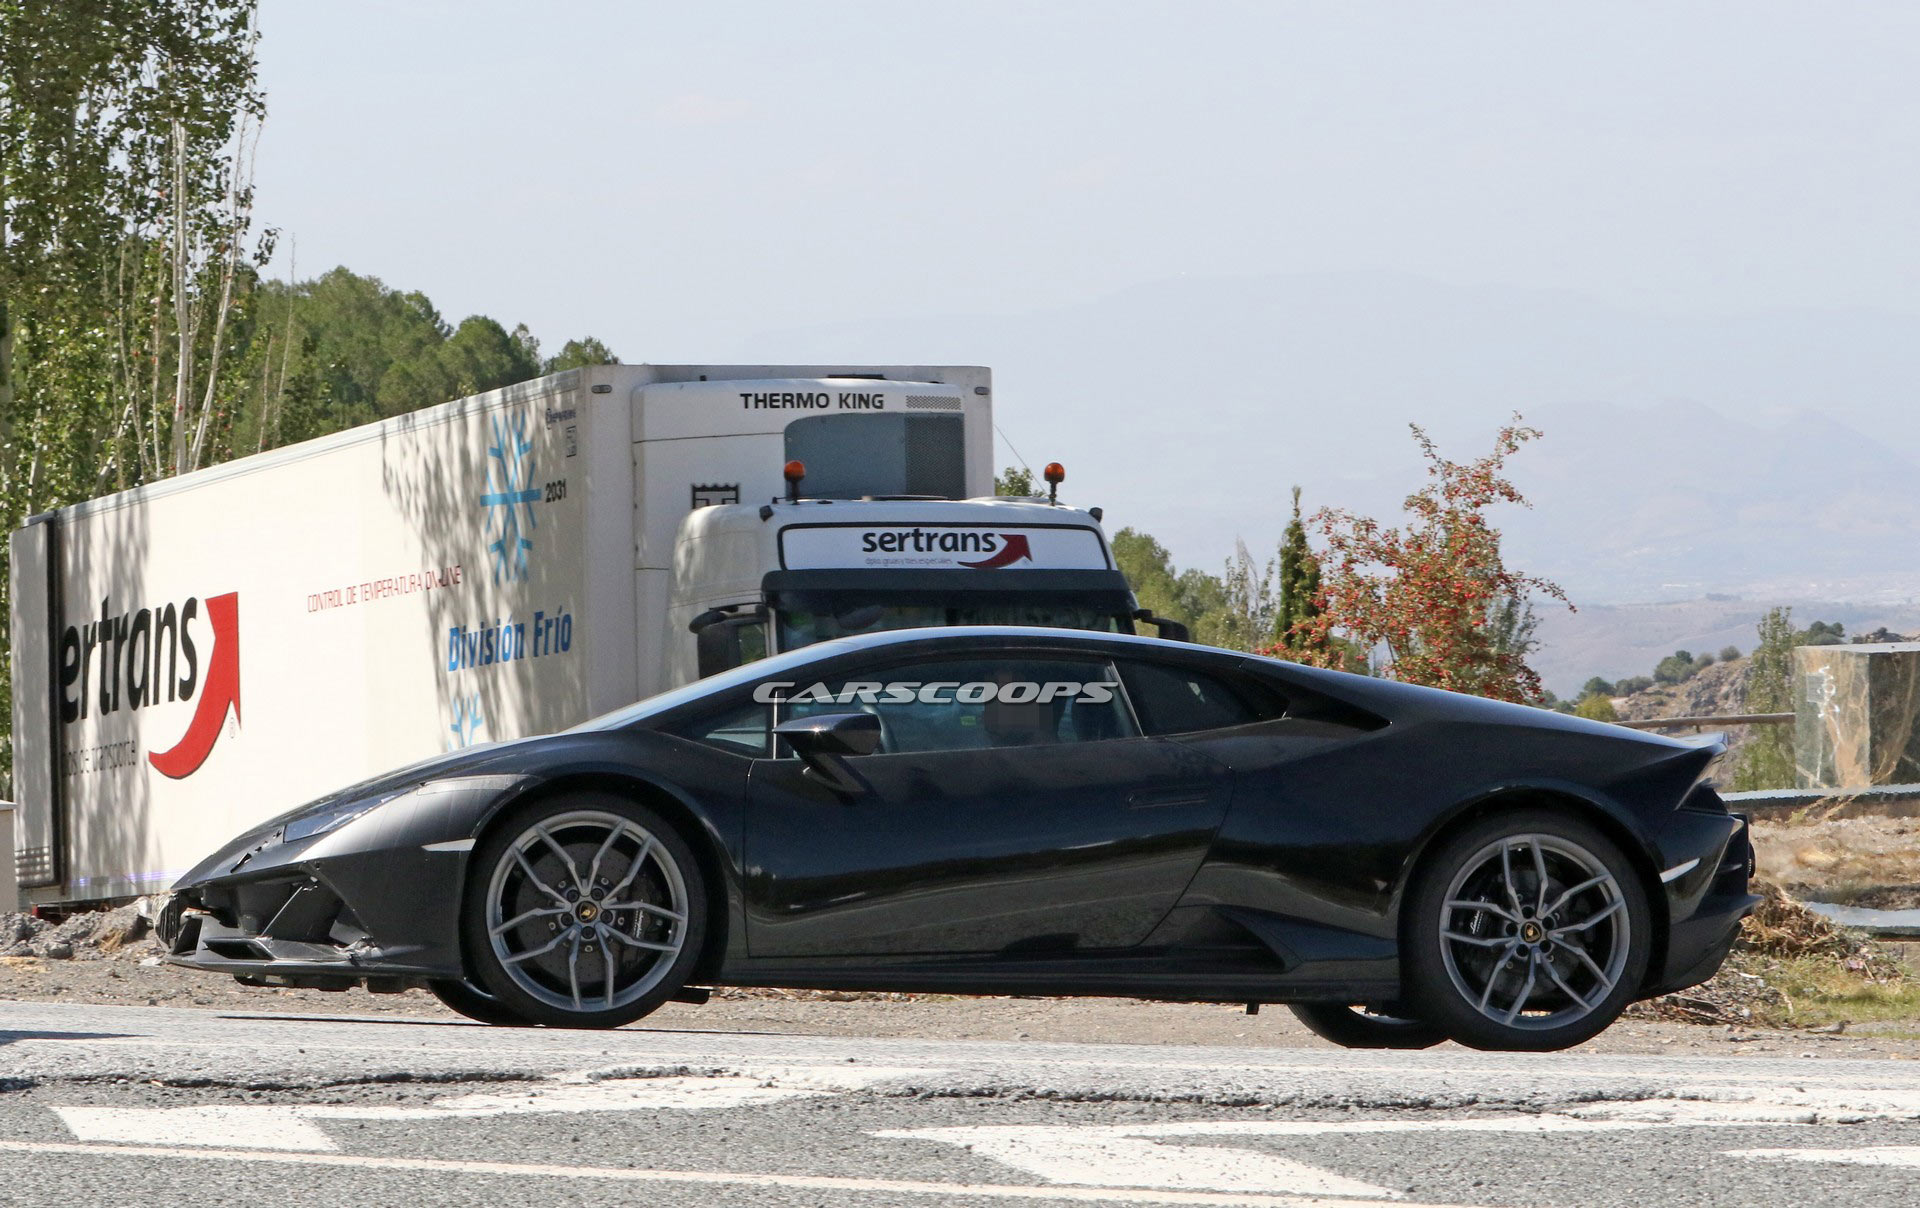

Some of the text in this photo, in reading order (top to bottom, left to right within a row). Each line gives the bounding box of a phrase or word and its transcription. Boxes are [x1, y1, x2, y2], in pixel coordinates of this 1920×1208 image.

[740, 392, 885, 410] THERMO KING
[545, 478, 567, 503] 2031
[862, 527, 997, 553] sertrans
[307, 588, 344, 614] CONTROL
[346, 585, 357, 605] DE
[359, 572, 424, 602] TEMPERATURA
[448, 605, 572, 672] División Frío
[59, 595, 198, 724] ertrans
